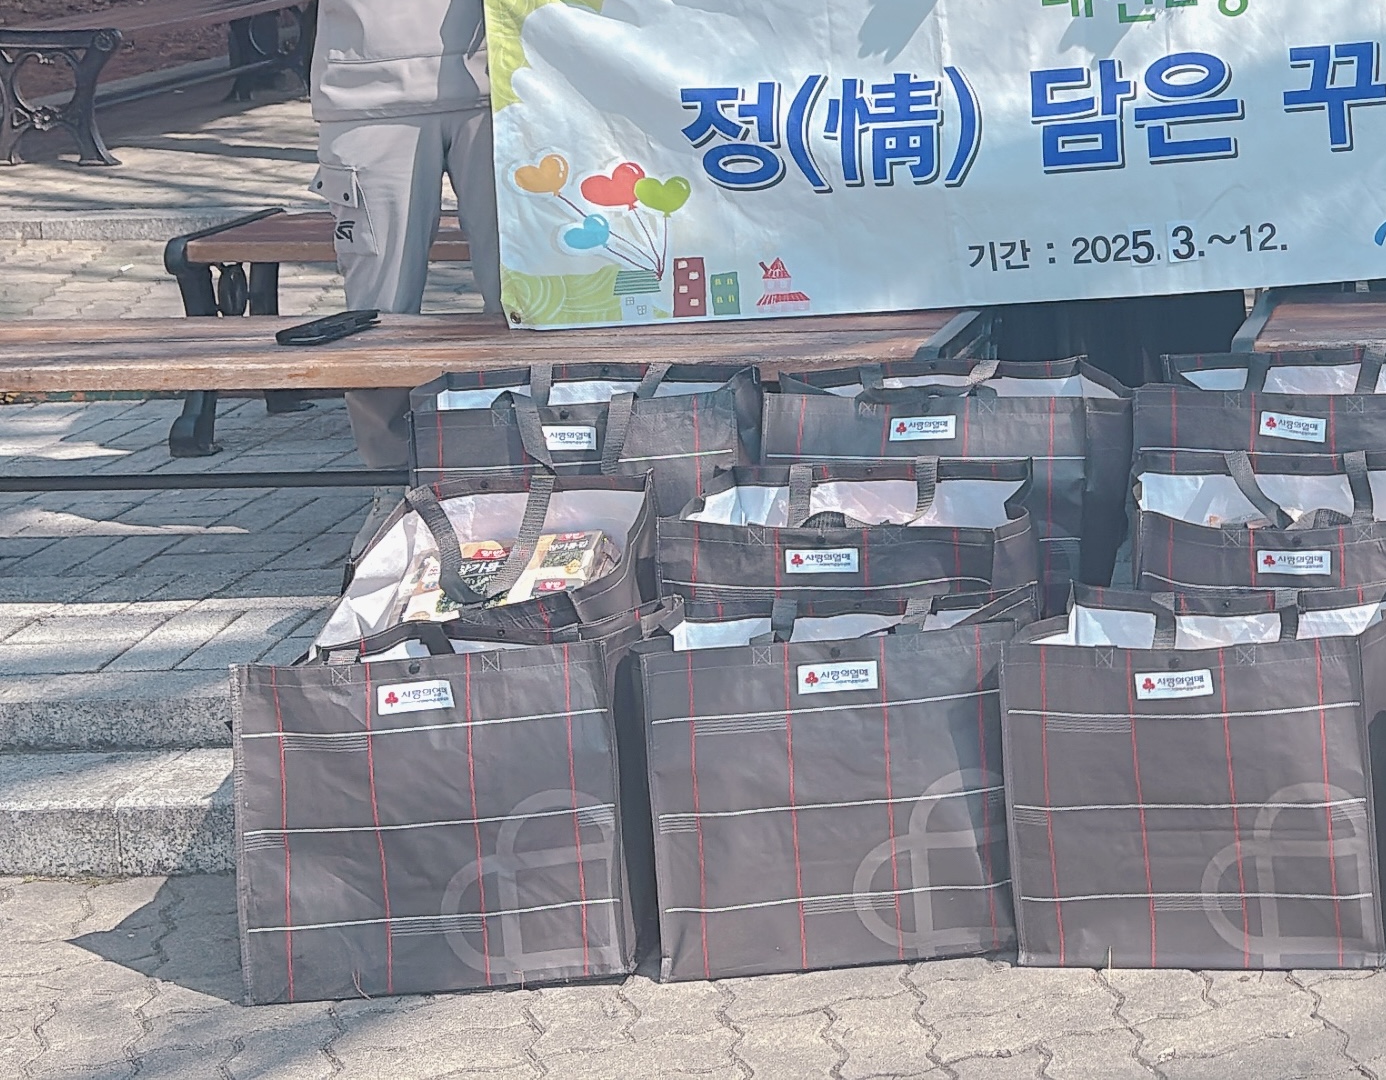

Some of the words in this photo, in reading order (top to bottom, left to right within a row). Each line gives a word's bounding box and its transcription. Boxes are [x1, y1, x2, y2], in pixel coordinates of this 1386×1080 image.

[680, 65, 983, 194] 정(情)
[1028, 51, 1242, 174] 담은
[967, 239, 1031, 272] 기간
